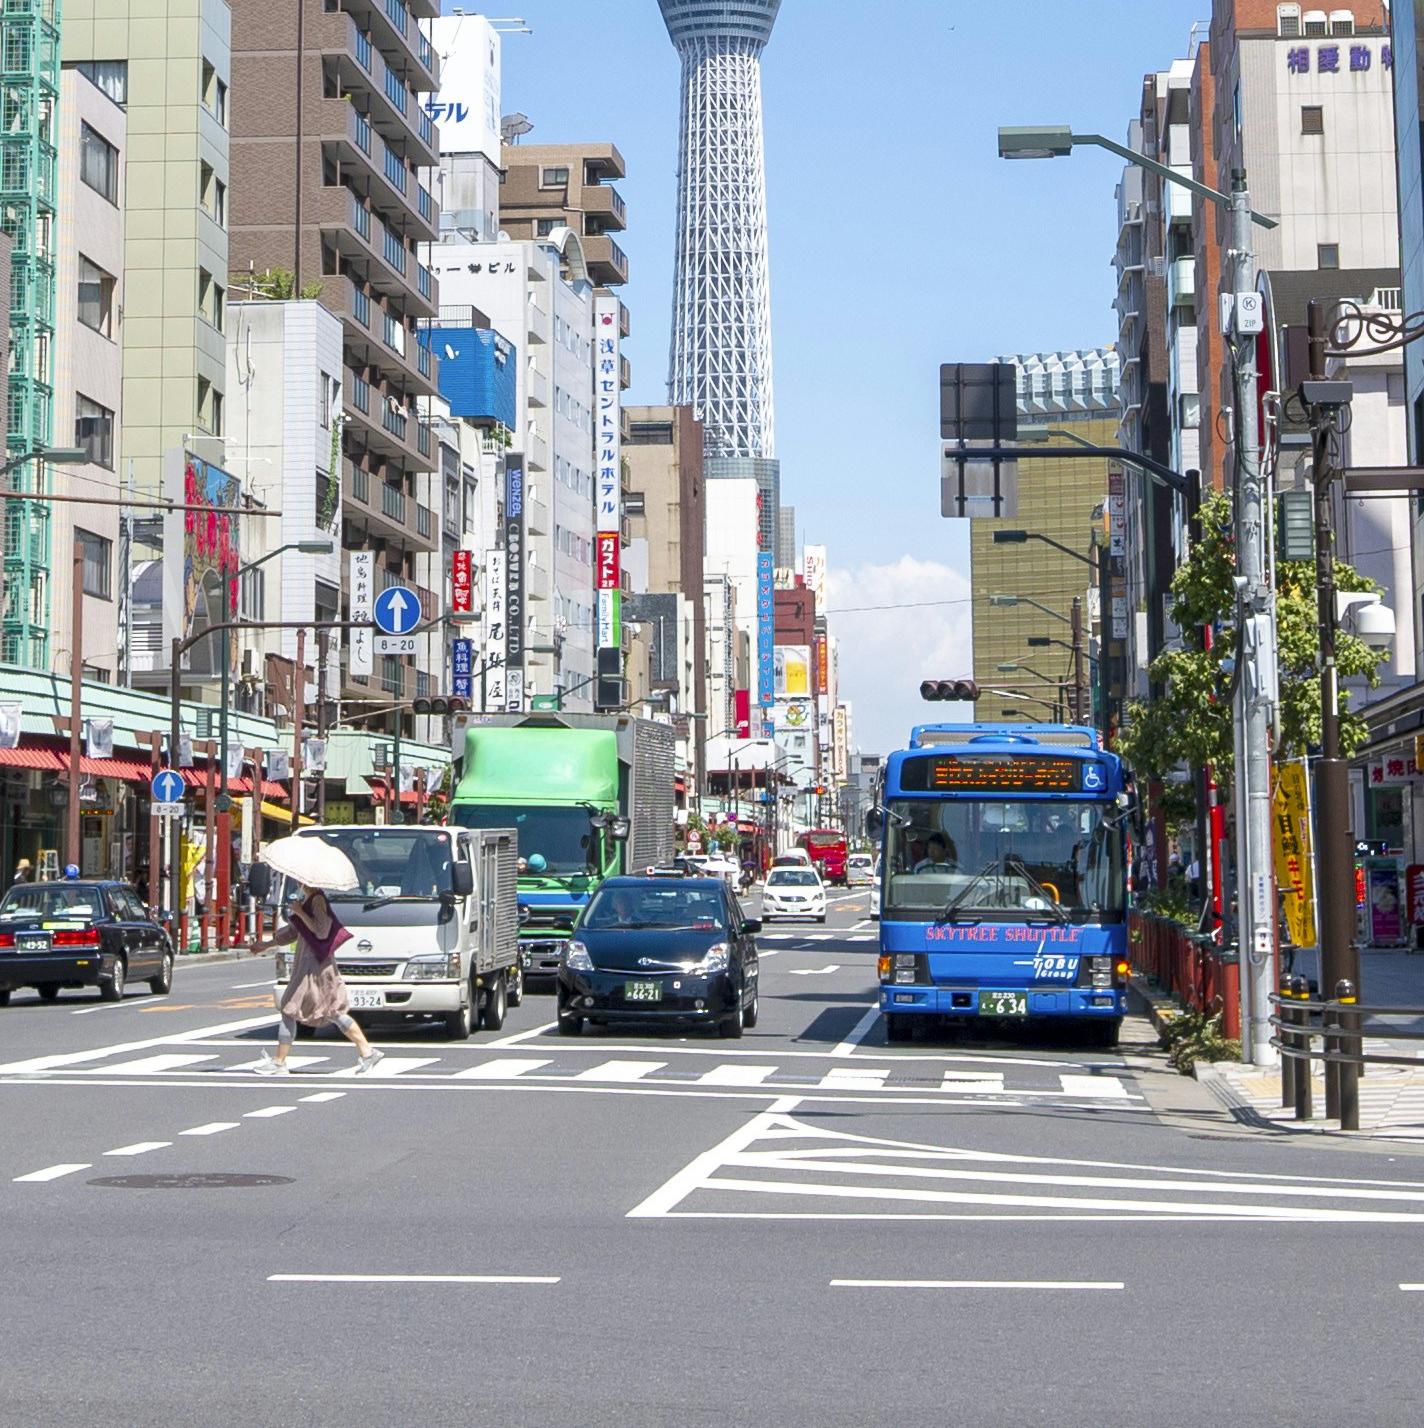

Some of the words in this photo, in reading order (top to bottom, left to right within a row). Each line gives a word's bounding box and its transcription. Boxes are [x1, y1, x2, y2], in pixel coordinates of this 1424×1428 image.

[599, 338, 616, 515] 浅草セントラルホテル
[601, 538, 615, 579] ガスト
[381, 639, 414, 650] 8-20
[926, 926, 1000, 941] SKYTREE
[1005, 927, 1084, 942] SHUTTLE
[1032, 958, 1079, 970] TOBU
[1040, 970, 1074, 980] Group
[632, 989, 659, 1000] 66-21
